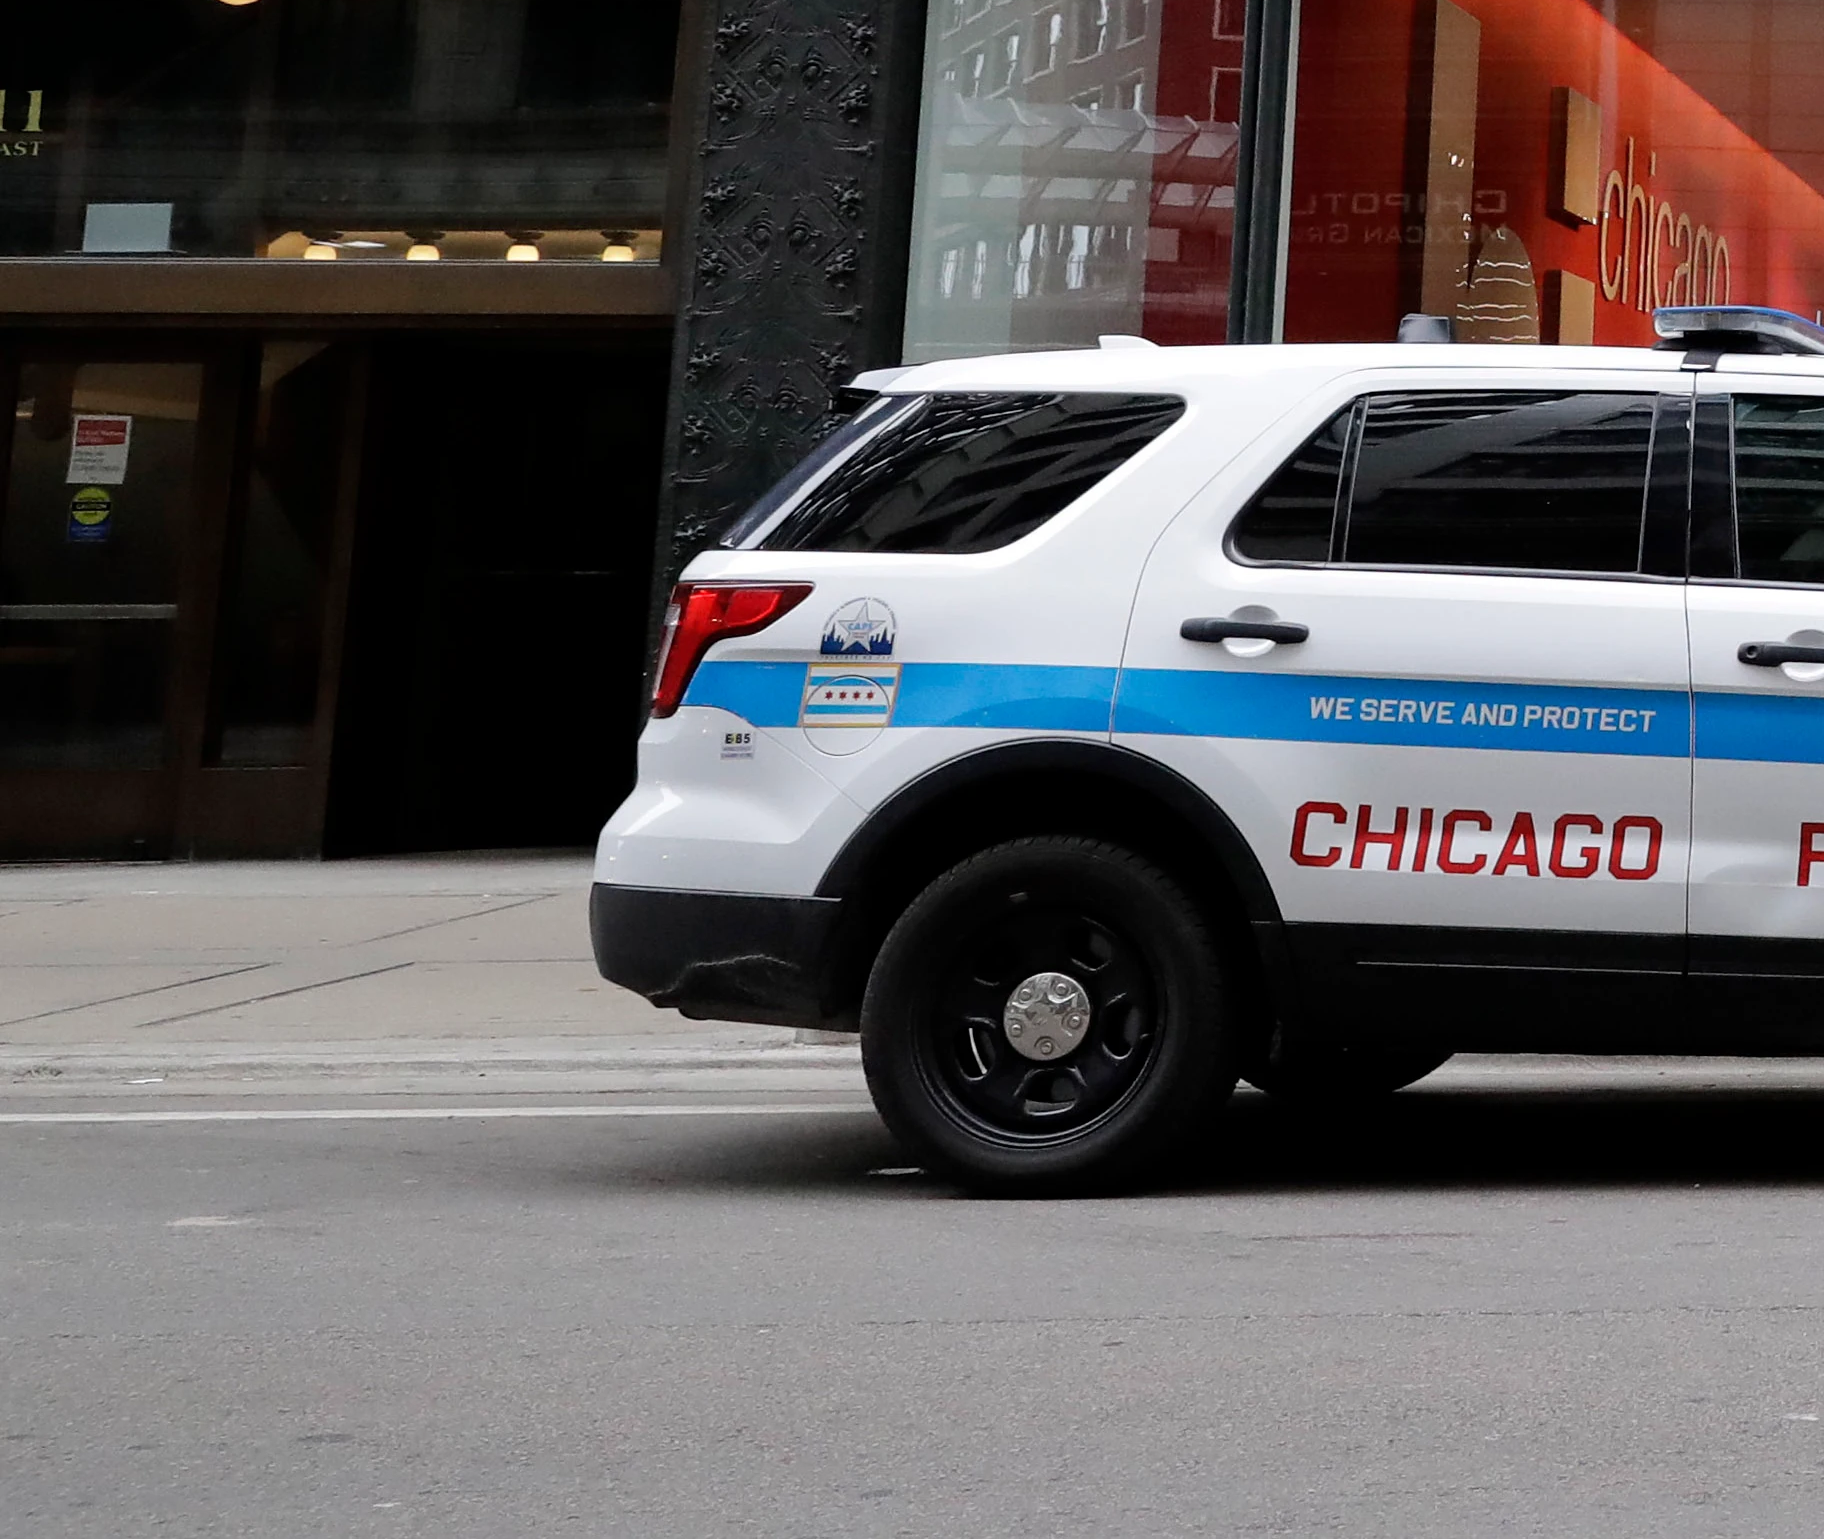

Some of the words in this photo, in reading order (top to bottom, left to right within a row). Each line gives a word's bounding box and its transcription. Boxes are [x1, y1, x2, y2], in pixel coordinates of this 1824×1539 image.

[1310, 697, 1354, 720] WE
[1360, 698, 1454, 725] SERVE
[1461, 702, 1517, 727] AND
[1523, 705, 1656, 733] PROTECT
[1290, 801, 1663, 880] CHICAGO
